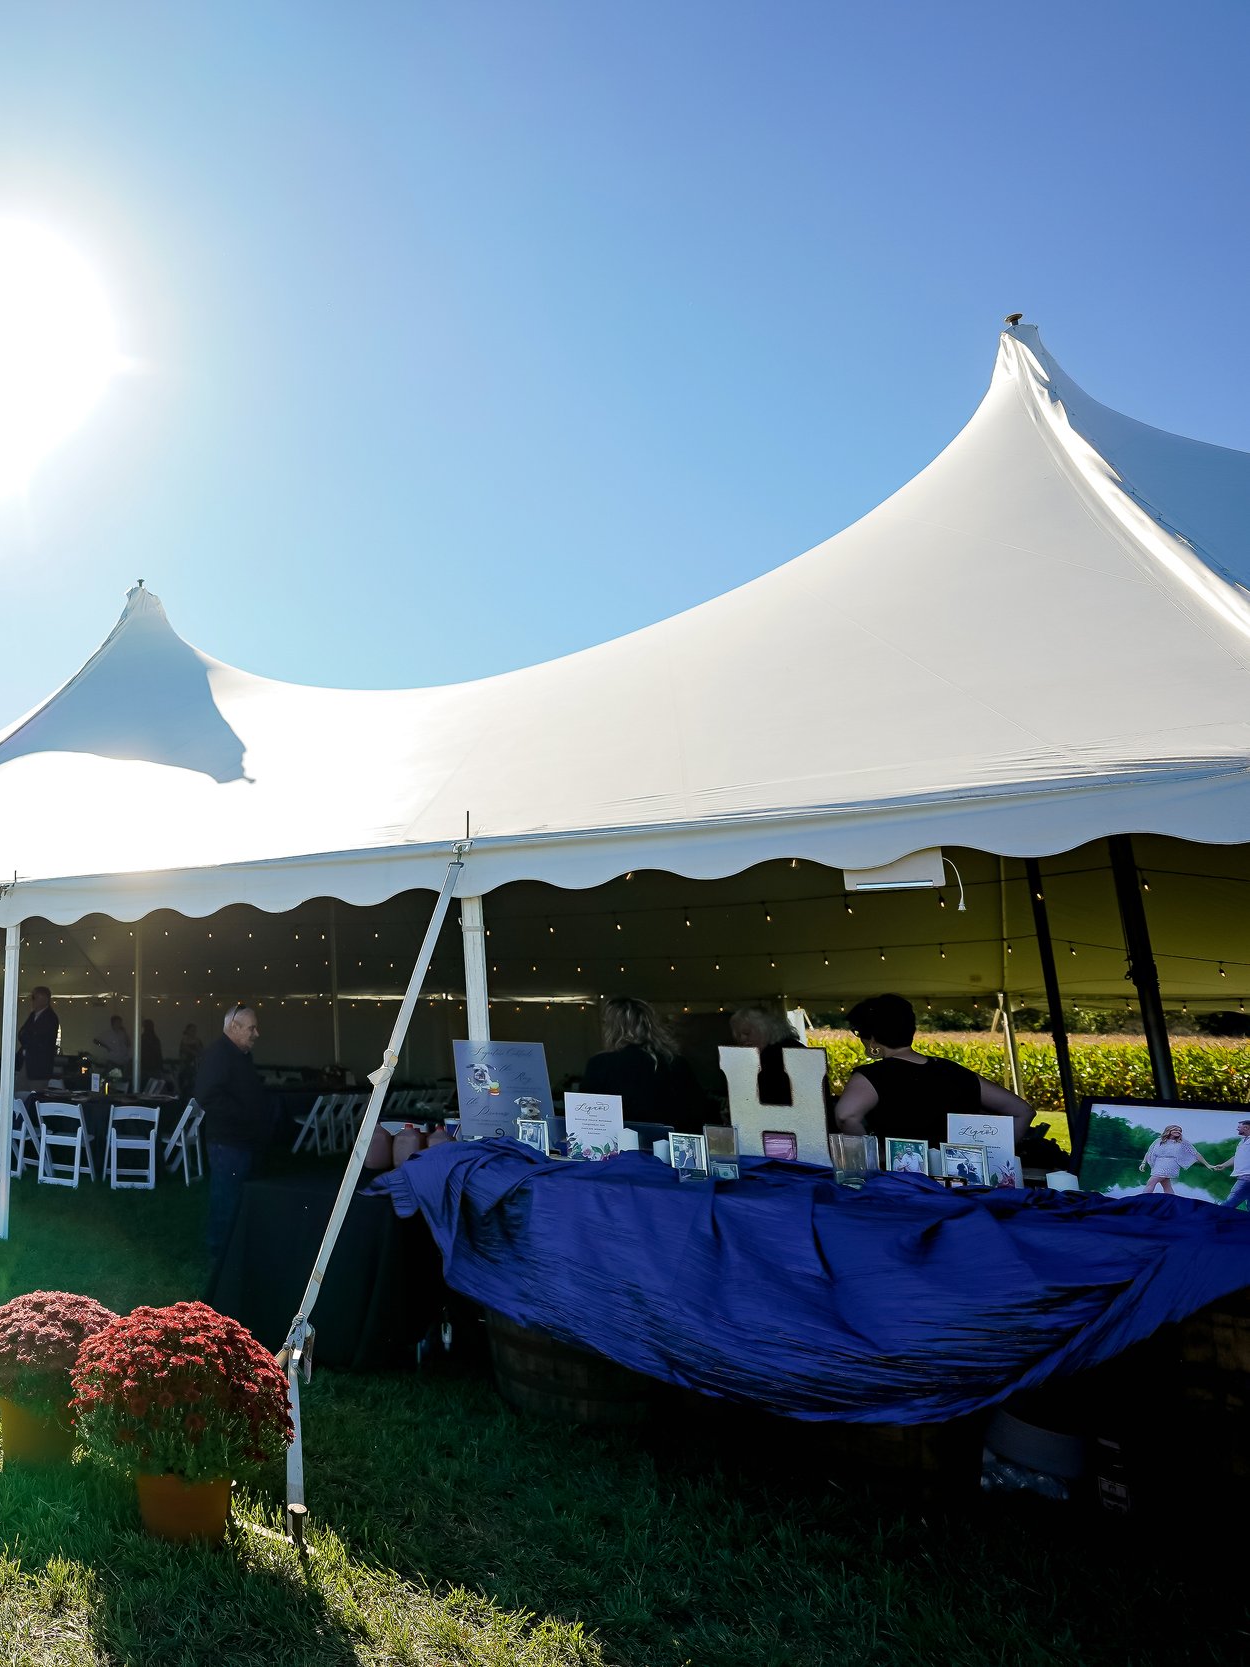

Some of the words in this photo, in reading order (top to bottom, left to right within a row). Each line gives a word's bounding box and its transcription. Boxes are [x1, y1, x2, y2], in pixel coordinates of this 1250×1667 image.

[574, 1101, 610, 1114] Liquor
[718, 1046, 833, 1168] H
[958, 1124, 999, 1139] Liquor
